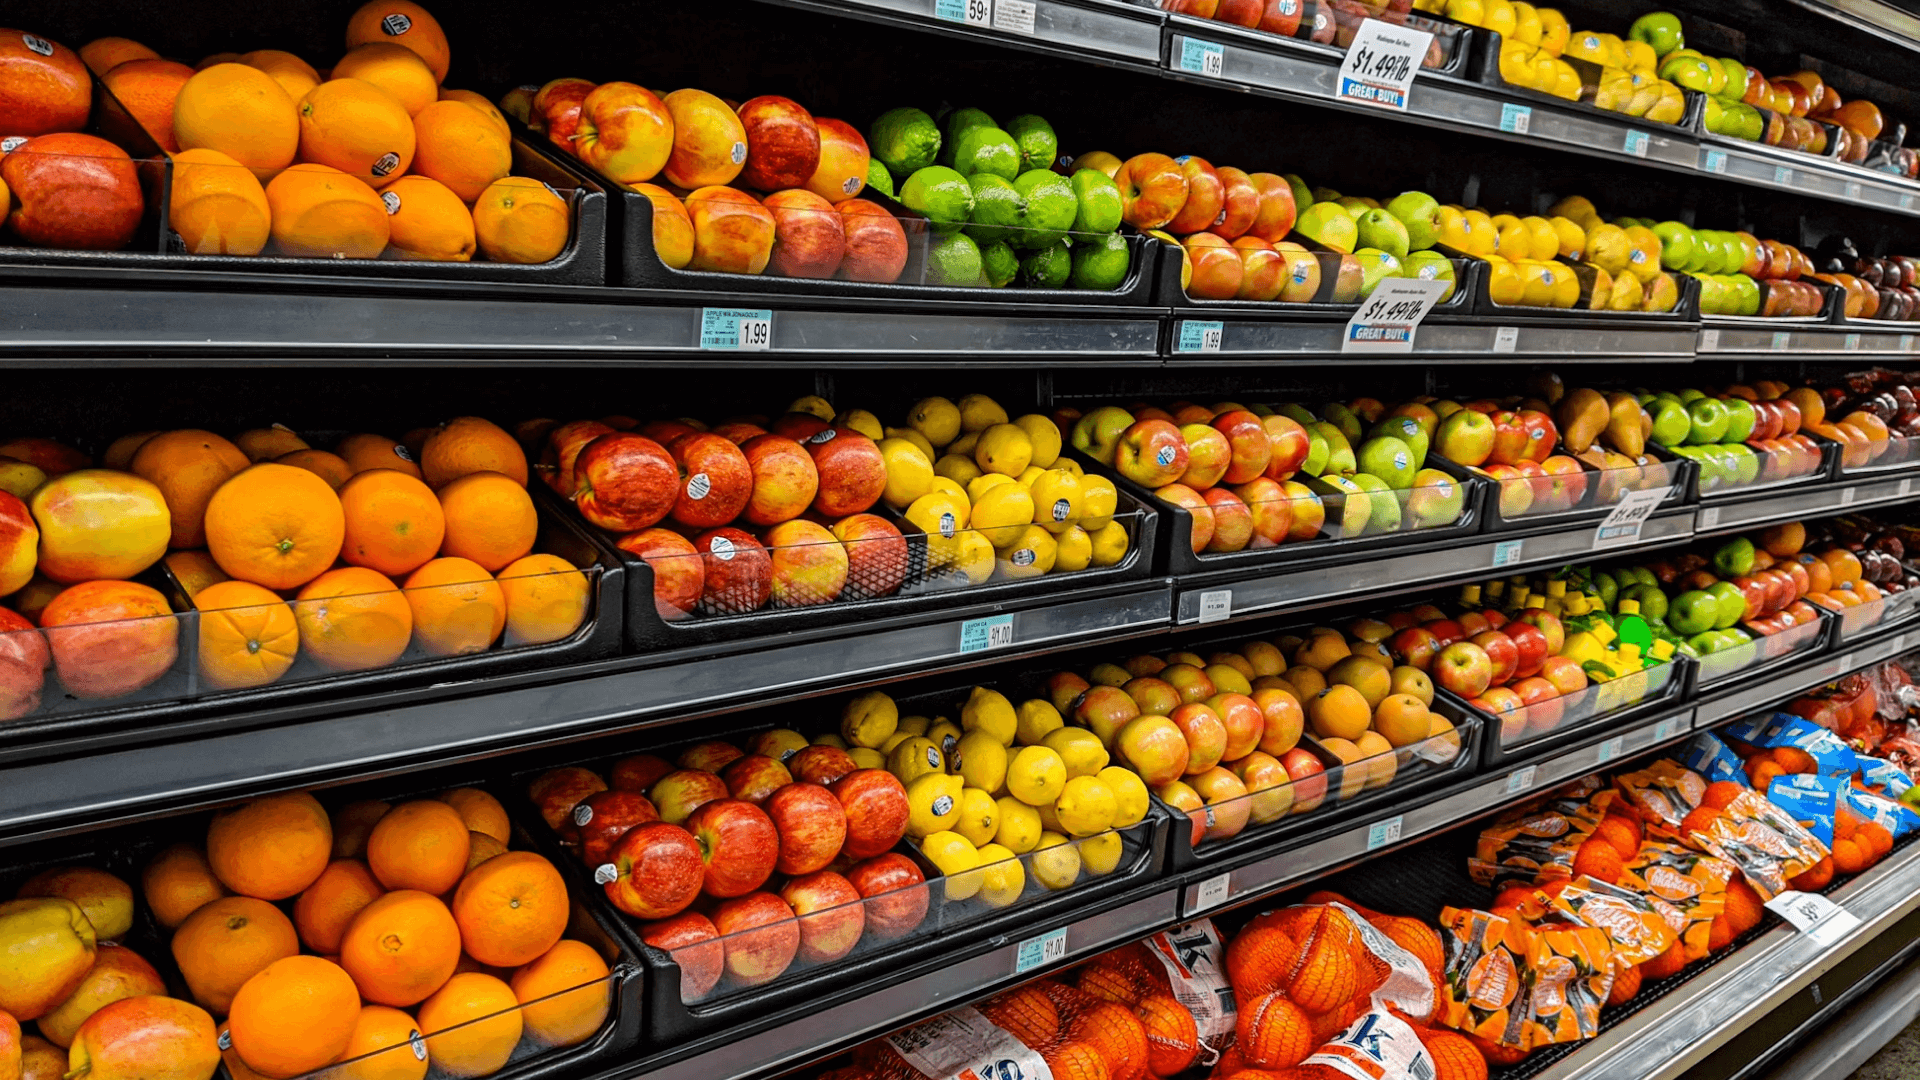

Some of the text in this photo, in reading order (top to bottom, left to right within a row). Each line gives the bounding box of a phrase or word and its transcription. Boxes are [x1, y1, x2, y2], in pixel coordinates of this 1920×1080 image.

[1352, 46, 1396, 79] $1.49
[1348, 82, 1377, 100] GREAT
[1377, 88, 1400, 105] BUY!
[1363, 299, 1410, 321] $1.49
[744, 322, 768, 344] 1.99
[1205, 331, 1220, 348] 1.99
[1356, 326, 1405, 340] GREAT BUY!
